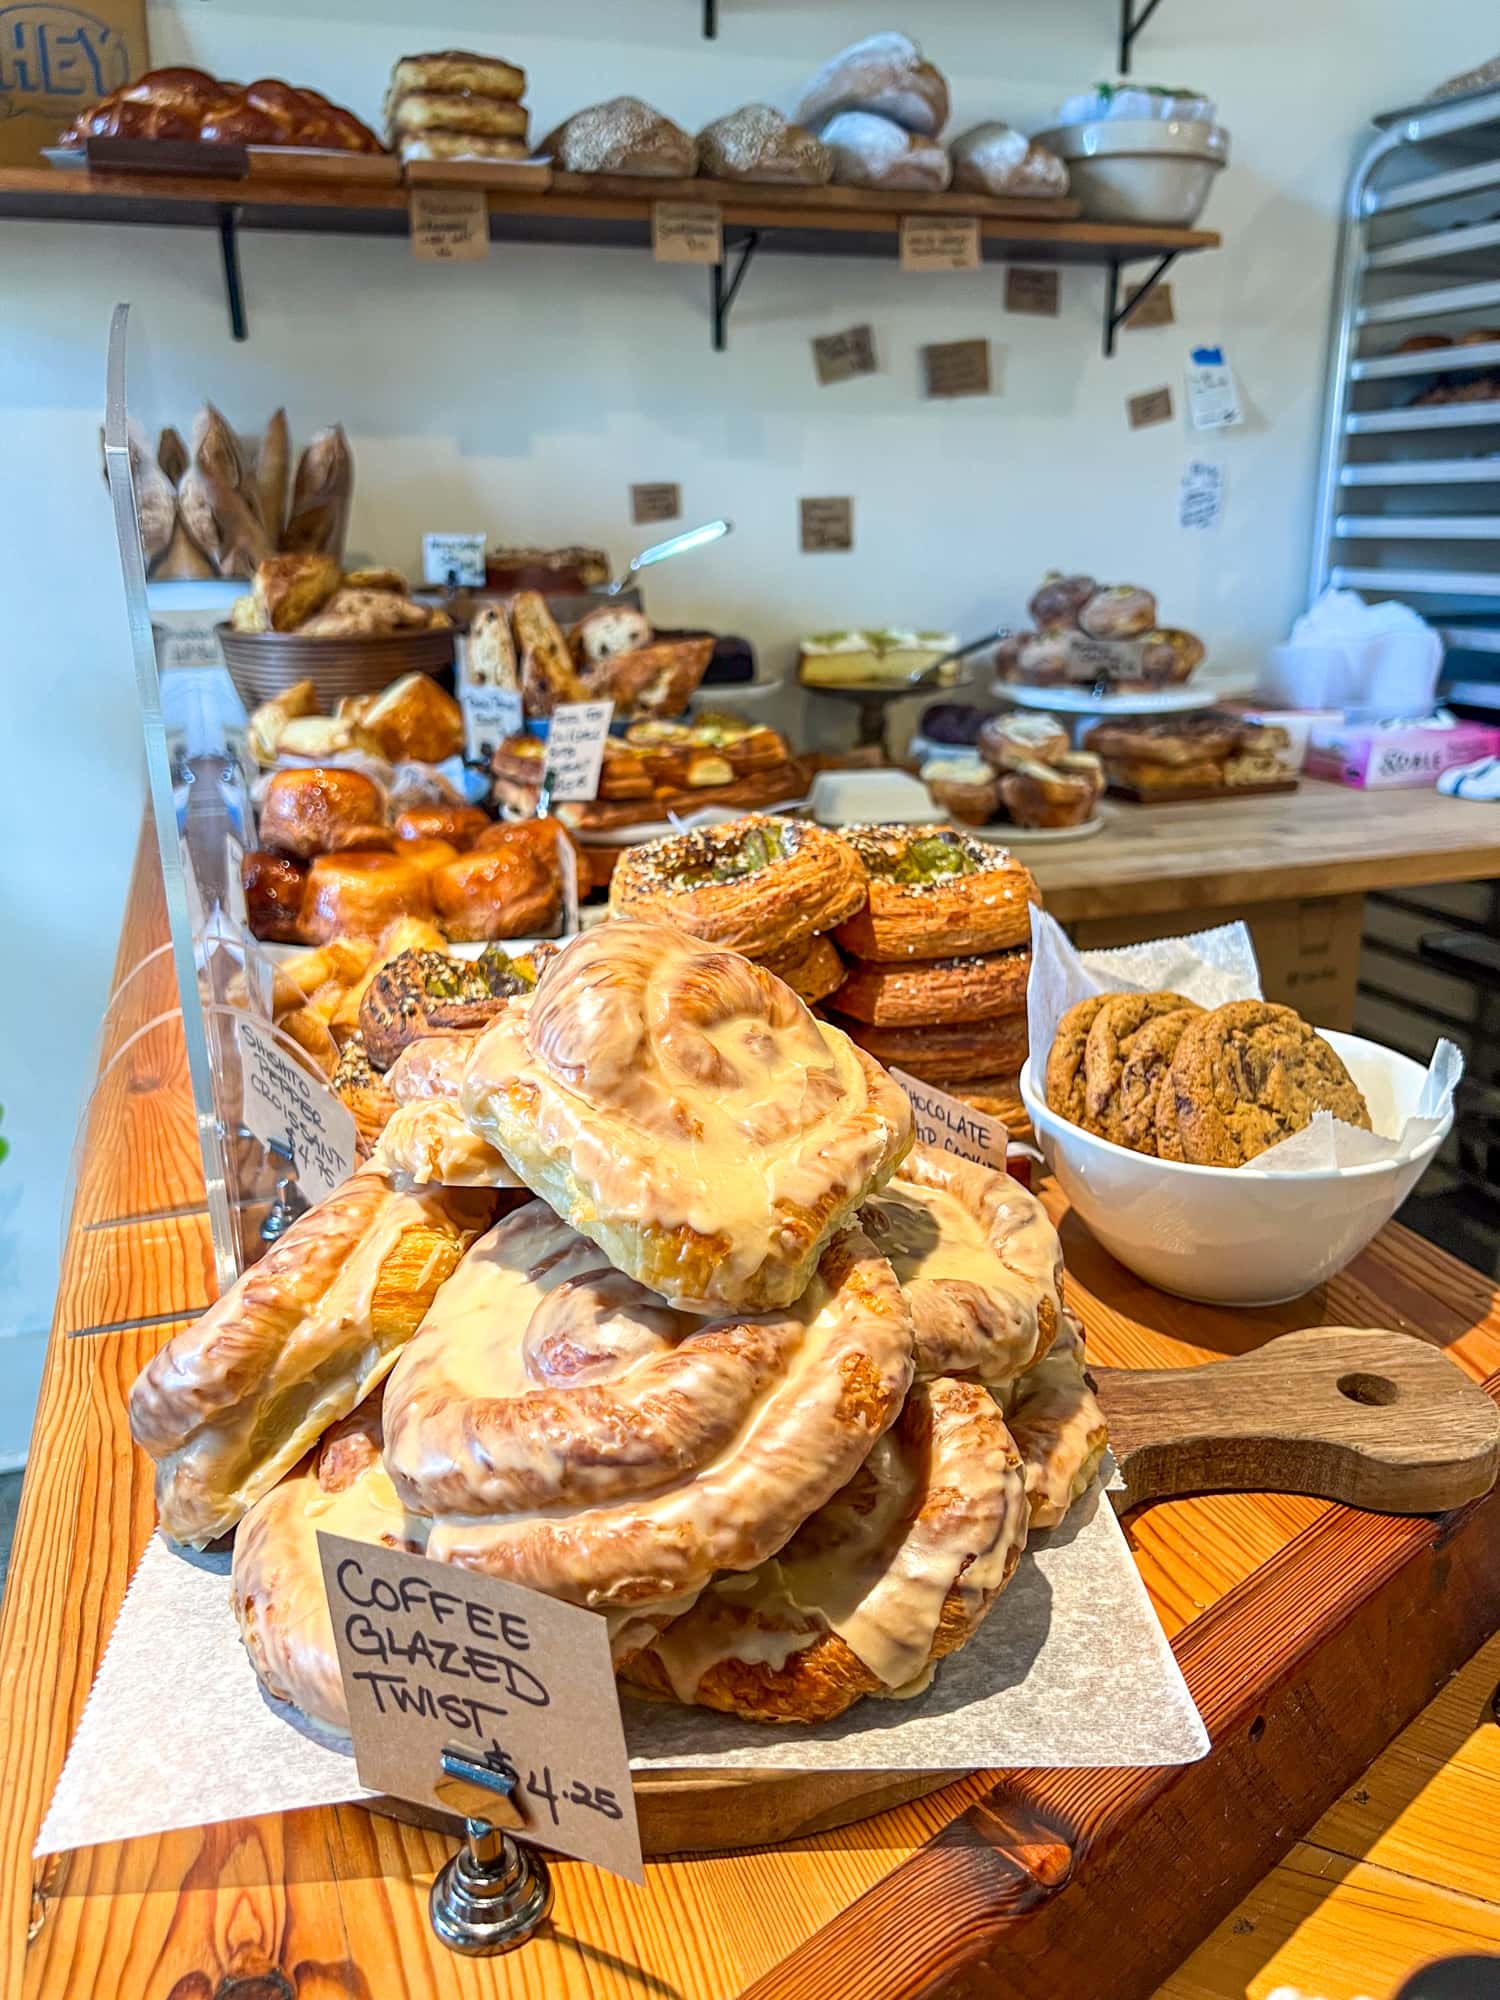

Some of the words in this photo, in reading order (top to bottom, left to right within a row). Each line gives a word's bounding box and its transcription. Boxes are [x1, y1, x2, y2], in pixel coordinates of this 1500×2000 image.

[0, 20, 111, 97] HEY
[251, 1073, 347, 1172] CROISSANT
[254, 1052, 326, 1133] PEPPER
[900, 1083, 992, 1149] HOCOLATE
[337, 1559, 530, 1650] COFFEE
[346, 1614, 551, 1707] GLAZED
[352, 1671, 508, 1738] TWIST
[484, 1738, 623, 1825] $4.25
